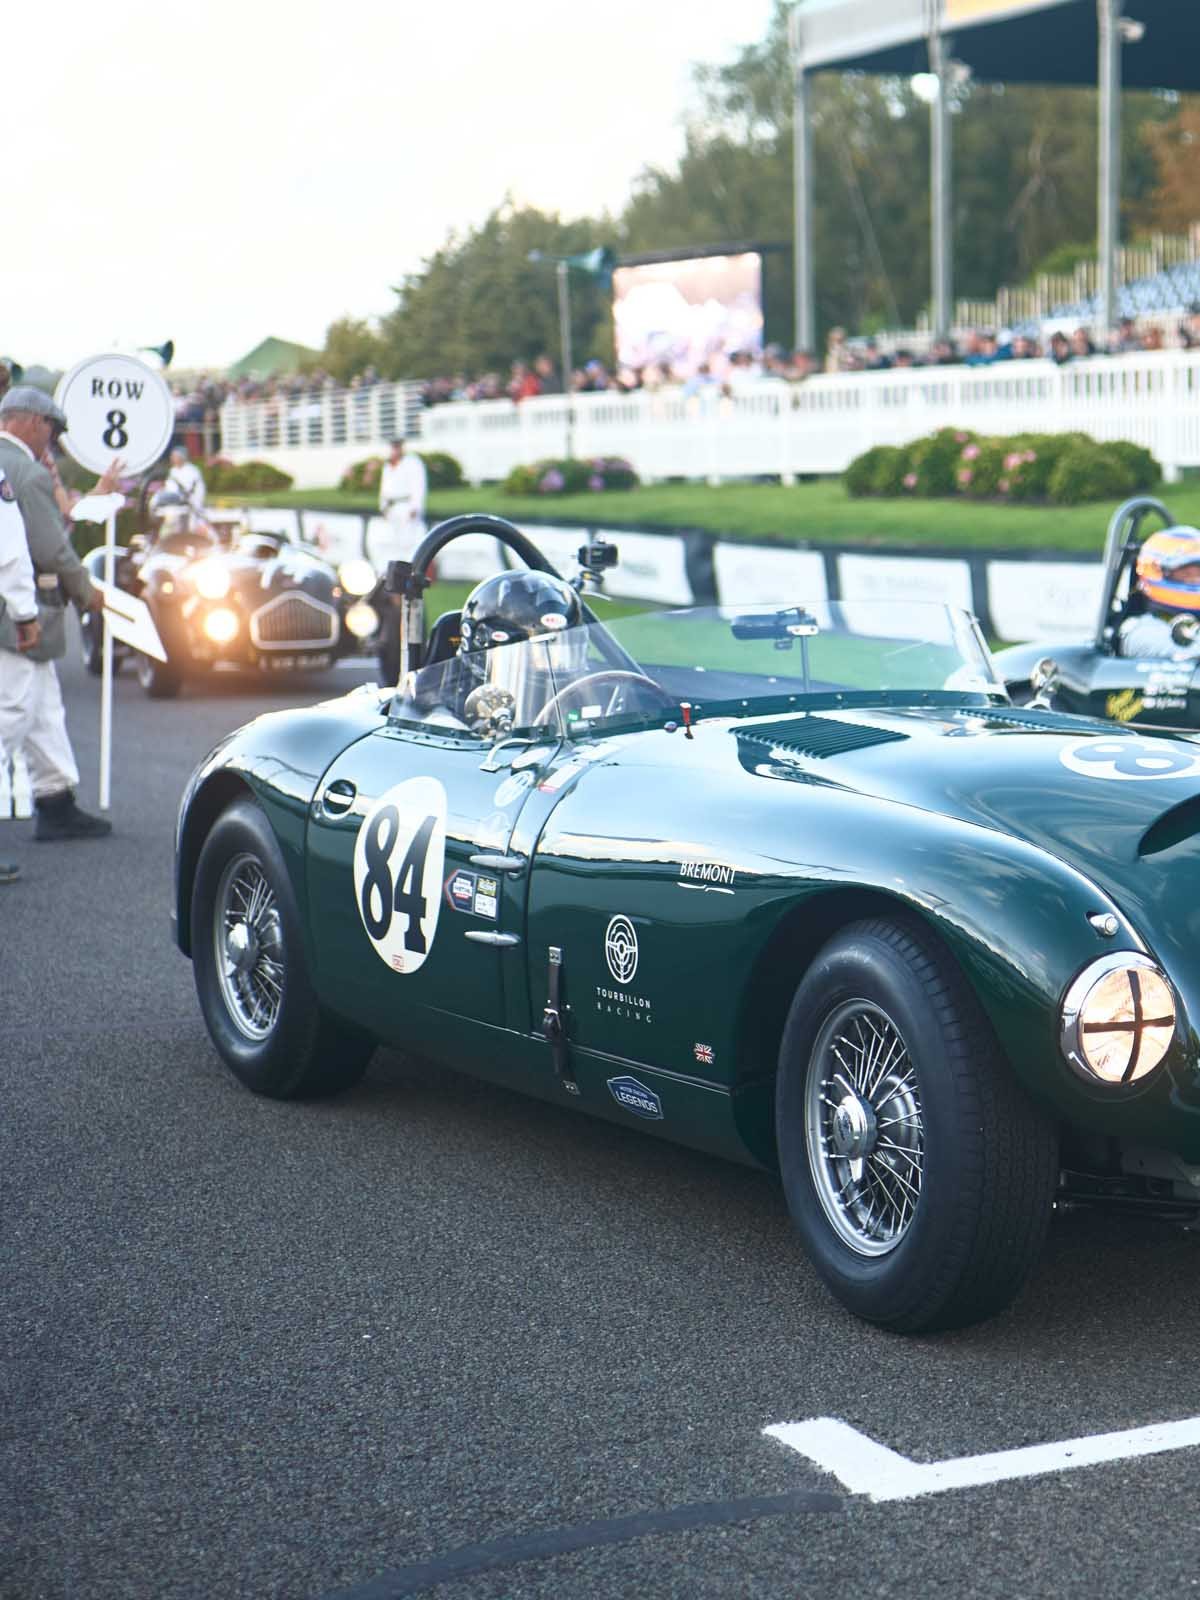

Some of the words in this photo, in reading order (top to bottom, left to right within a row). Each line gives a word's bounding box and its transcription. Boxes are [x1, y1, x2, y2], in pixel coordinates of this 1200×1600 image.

[91, 377, 144, 401] ROW
[102, 409, 129, 450] 8
[362, 804, 438, 955] 84
[680, 861, 736, 885] BREMONT
[596, 986, 651, 1009] TOURBILLON
[615, 1090, 658, 1113] LEGENDS
